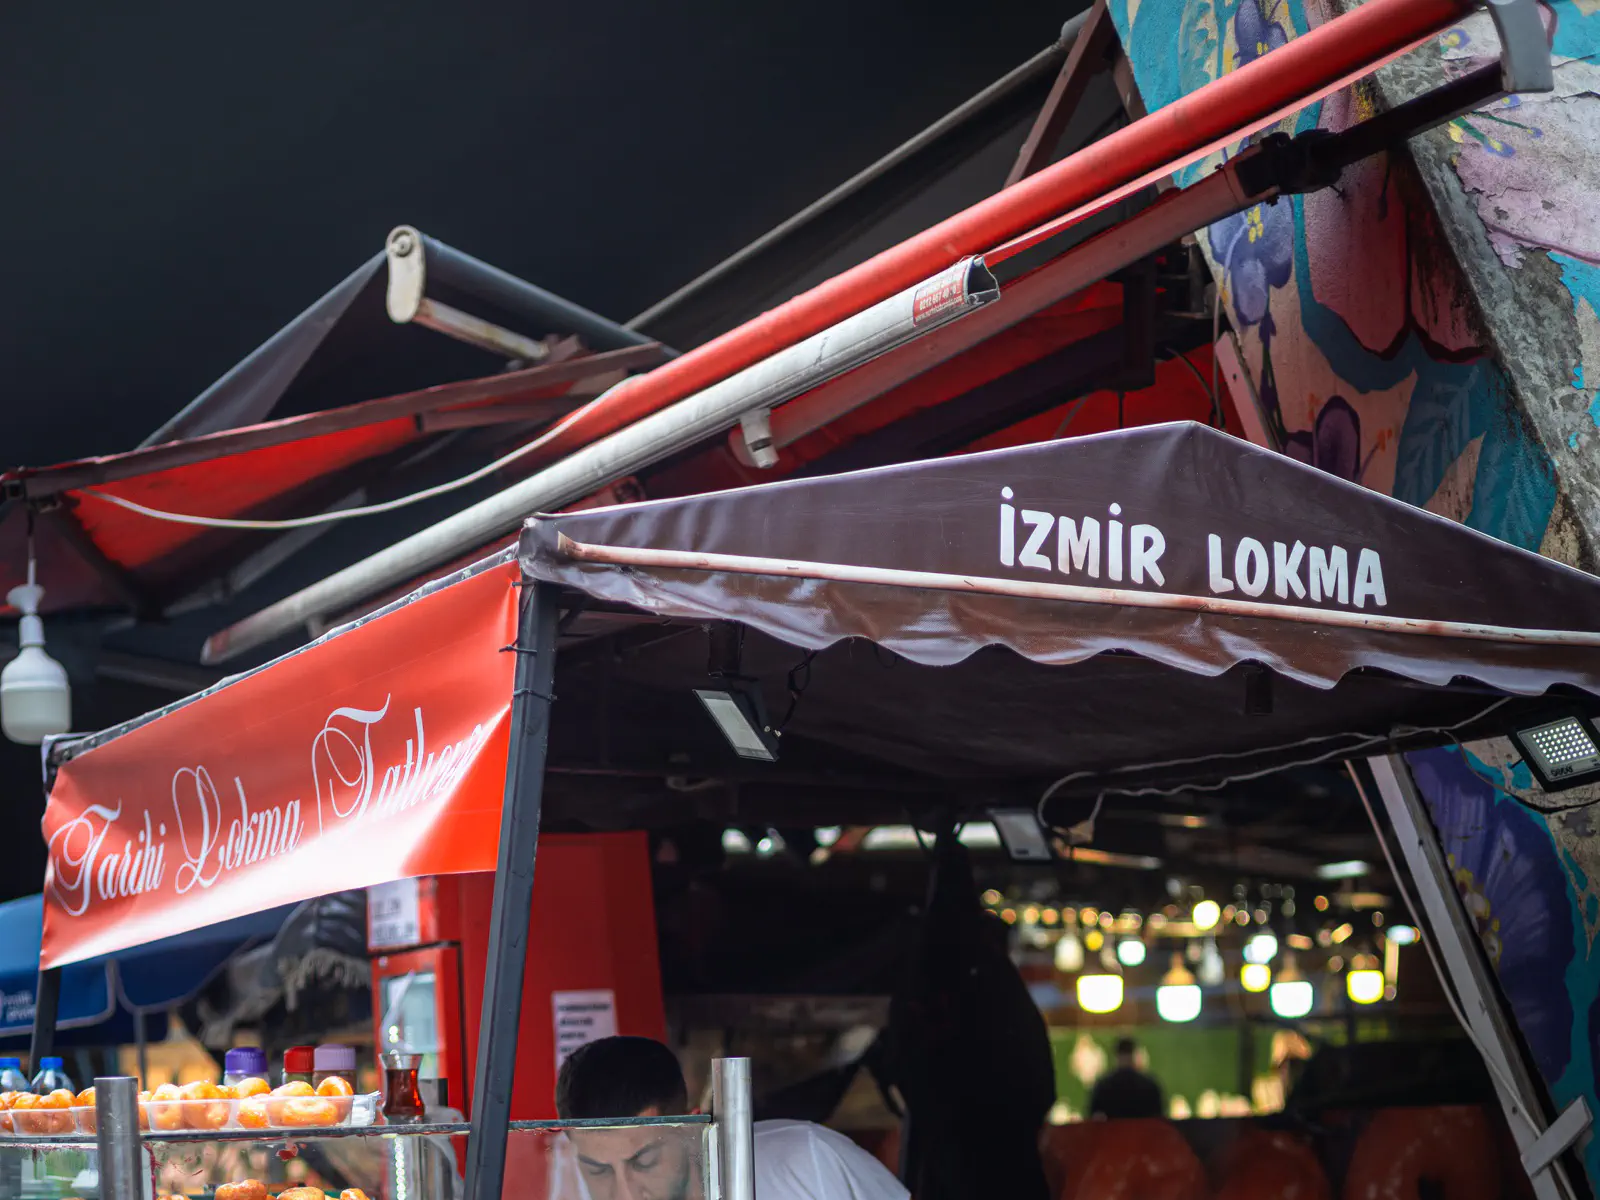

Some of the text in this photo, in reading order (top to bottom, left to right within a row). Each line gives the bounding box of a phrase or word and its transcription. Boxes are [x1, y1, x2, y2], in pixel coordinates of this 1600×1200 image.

[1000, 486, 1388, 608] İZMİR LOKMA
[47, 798, 166, 916] Tarihi
[172, 765, 304, 893] Lokma
